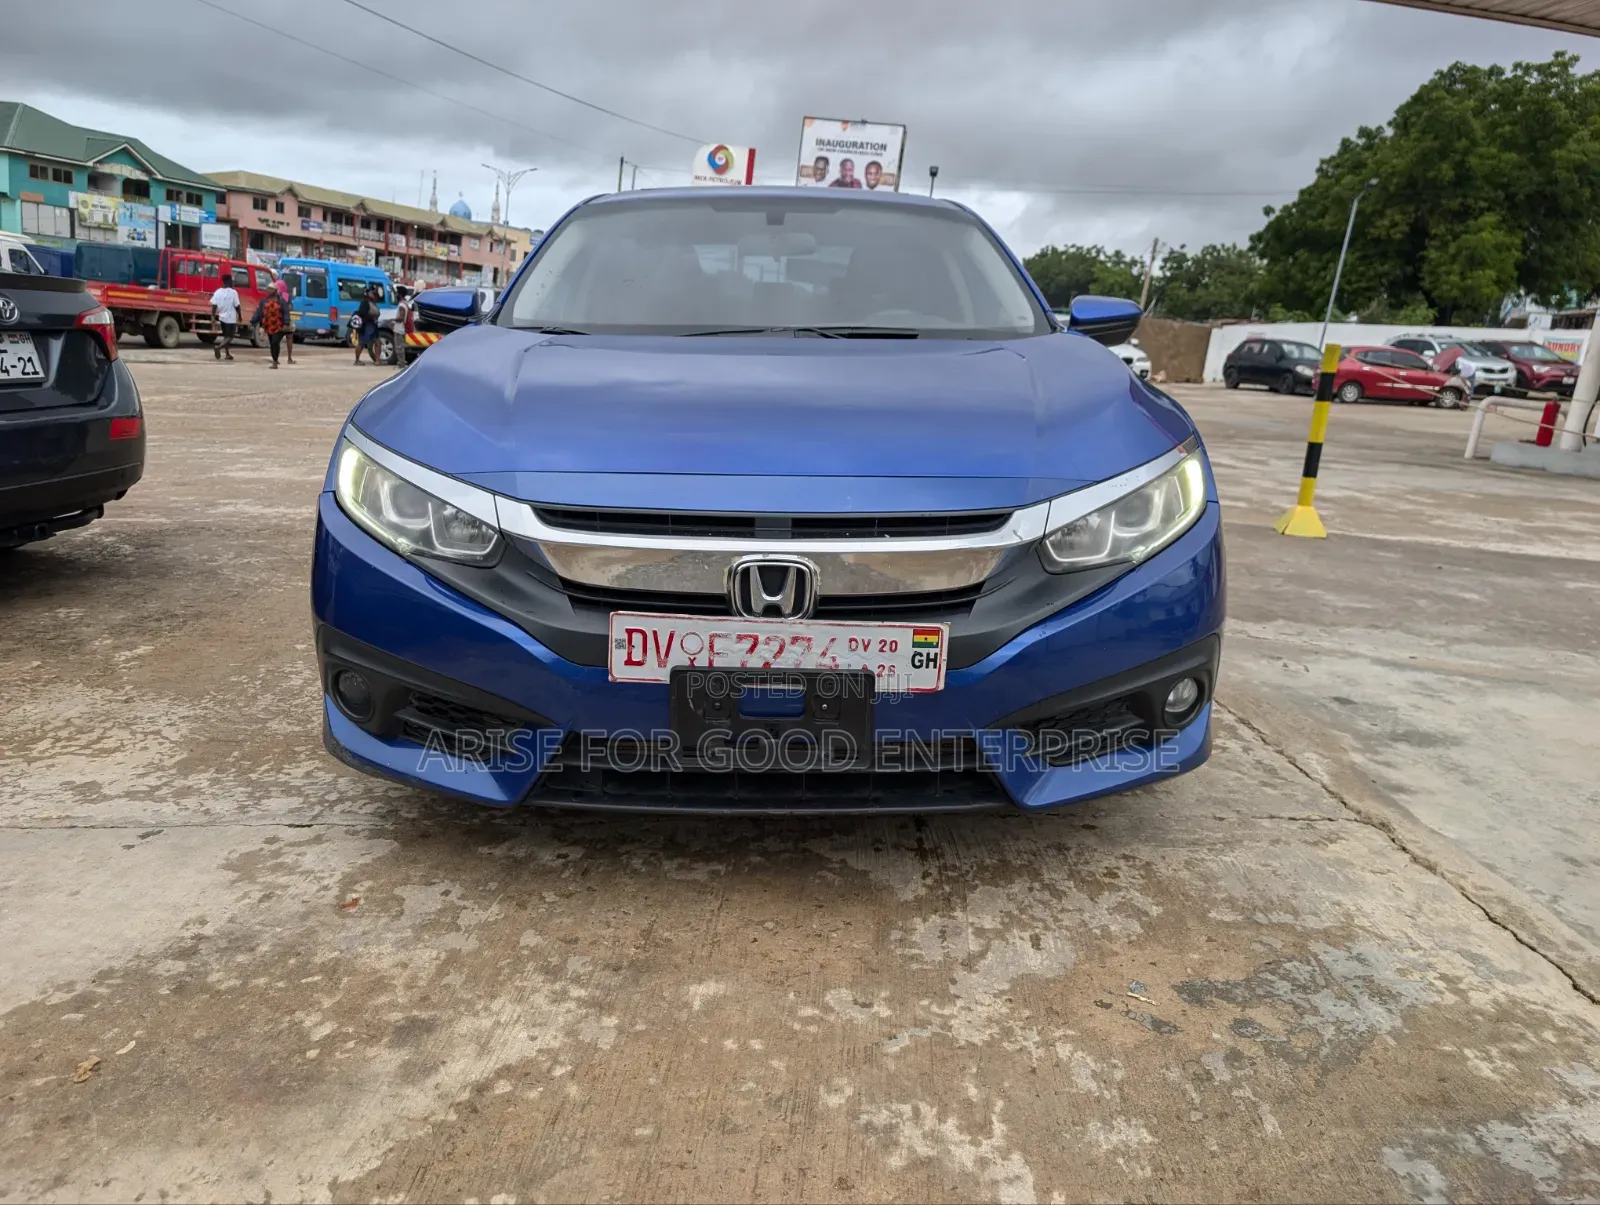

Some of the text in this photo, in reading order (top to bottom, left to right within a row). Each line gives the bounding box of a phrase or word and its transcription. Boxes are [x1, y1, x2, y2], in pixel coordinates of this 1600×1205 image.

[815, 137, 888, 152] INAUGURATION
[20, 333, 33, 344] GH
[623, 627, 676, 668] DV
[848, 637, 898, 653] DV 20
[911, 650, 938, 669] GH
